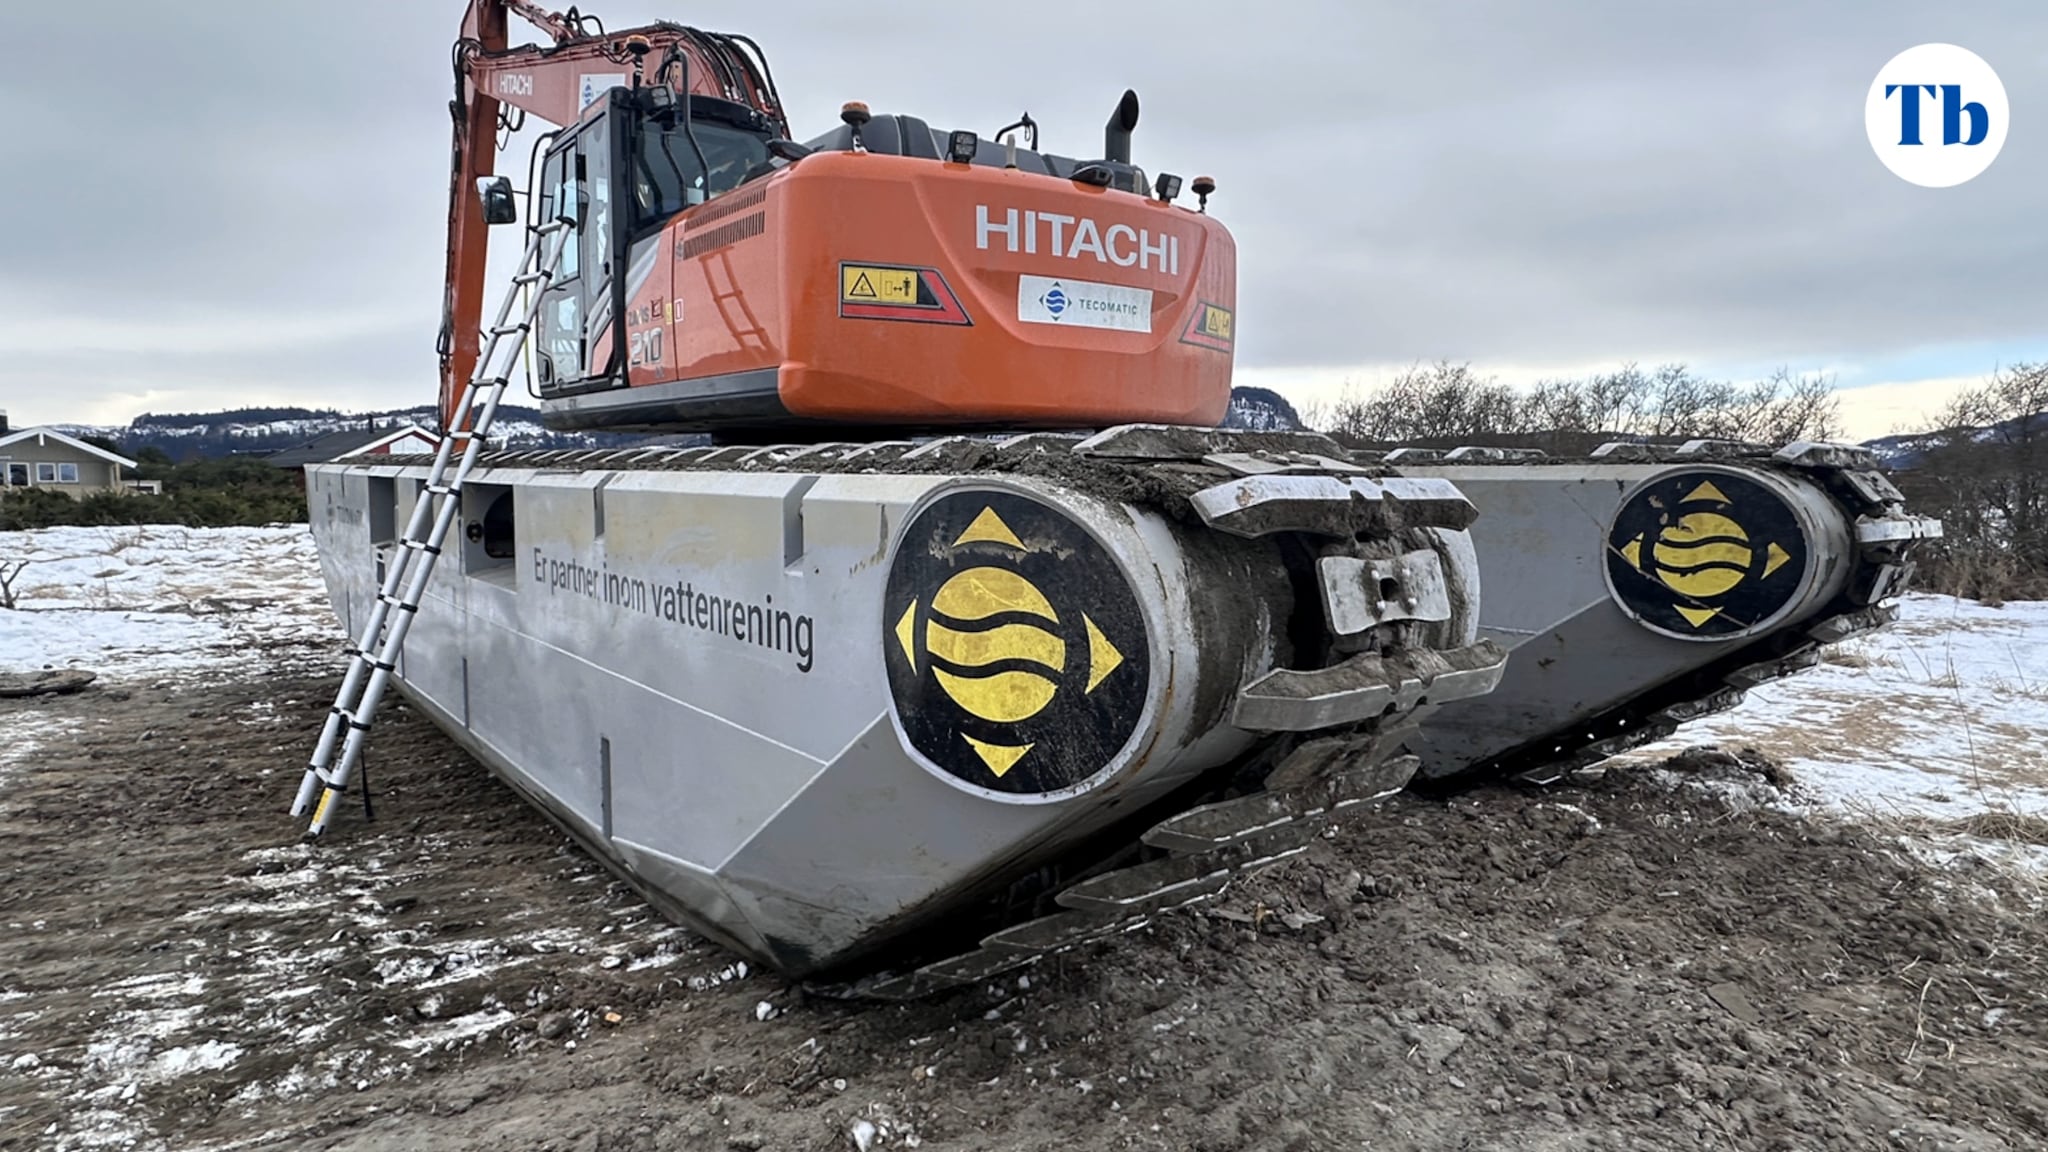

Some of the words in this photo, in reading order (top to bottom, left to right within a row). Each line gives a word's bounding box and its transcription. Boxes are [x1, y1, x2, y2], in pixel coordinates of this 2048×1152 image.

[499, 73, 534, 97] HITACHI
[975, 204, 1179, 275] HITACHI
[1079, 298, 1138, 316] TECOMATIC
[631, 327, 663, 366] 210
[534, 547, 547, 584] Er
[550, 557, 598, 600] partner
[602, 562, 647, 614] inom
[651, 581, 815, 673] vattenrening
